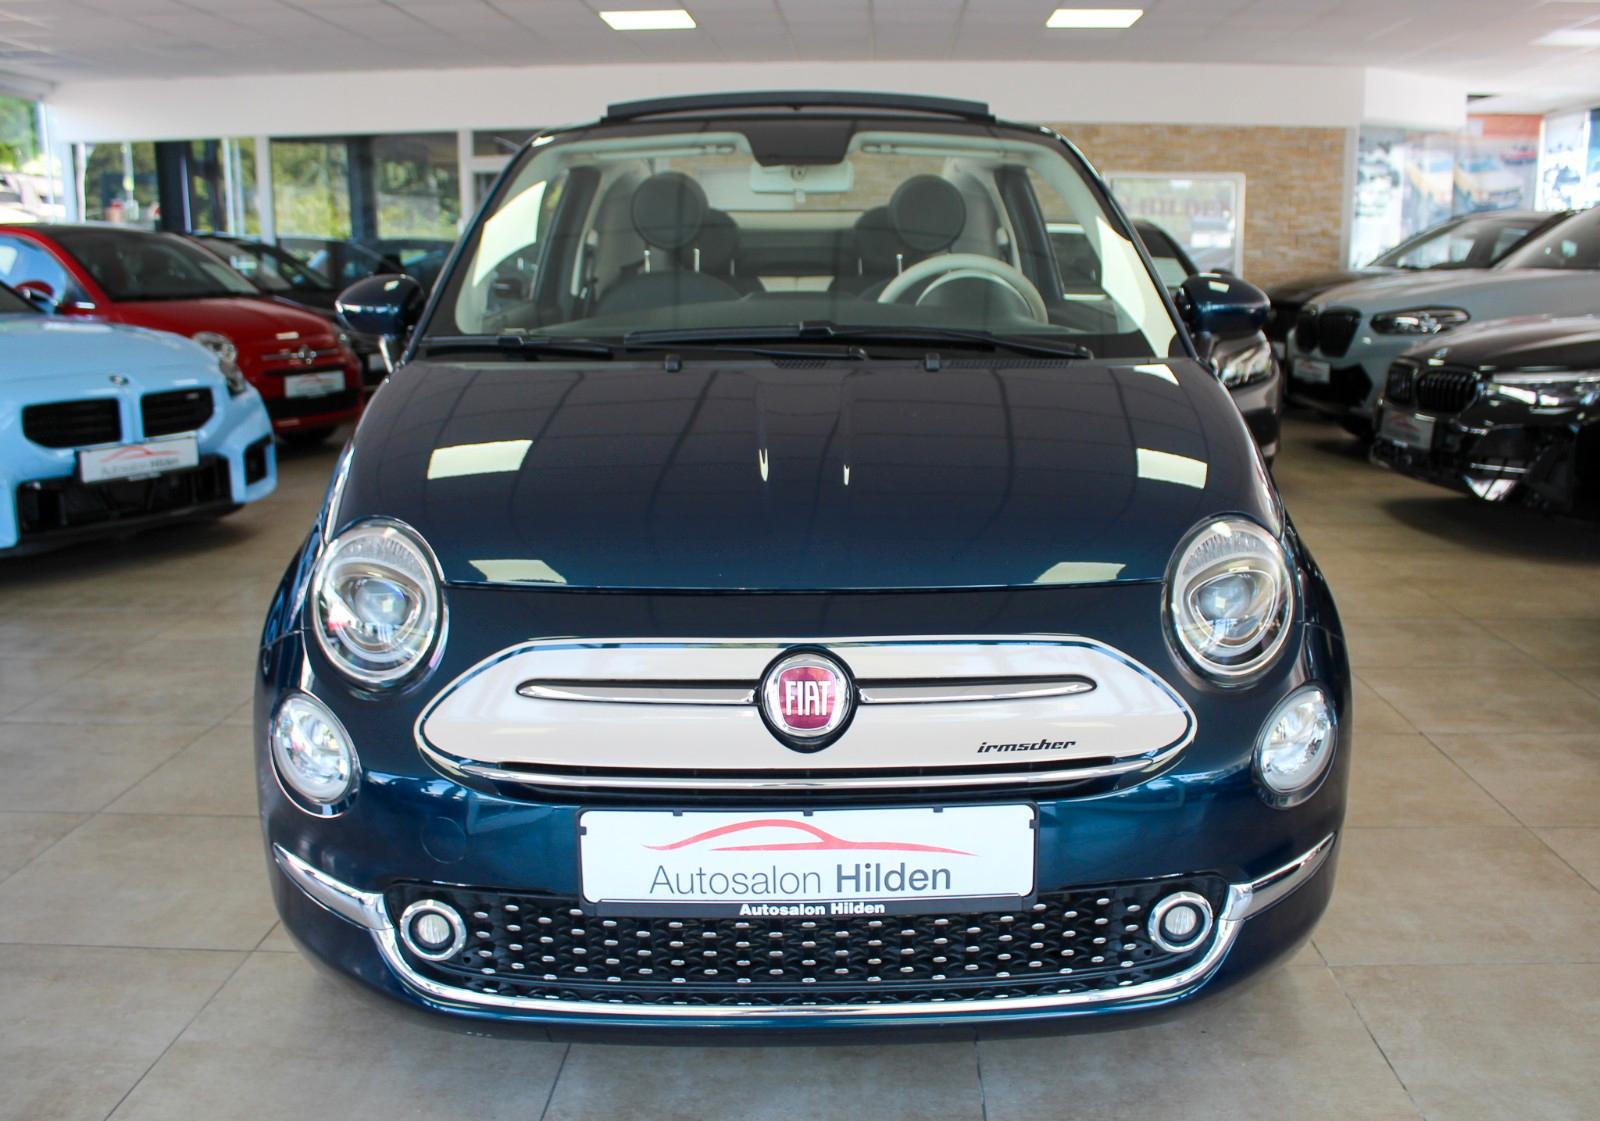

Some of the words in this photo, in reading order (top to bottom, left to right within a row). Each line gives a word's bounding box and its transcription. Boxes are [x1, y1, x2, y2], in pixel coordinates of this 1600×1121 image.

[785, 680, 832, 717] FIAT
[977, 739, 1076, 753] irmscher
[650, 864, 822, 895] Autosalon
[836, 862, 951, 893] Hilden
[739, 903, 826, 917] Autosalon
[830, 901, 885, 915] Hilden
